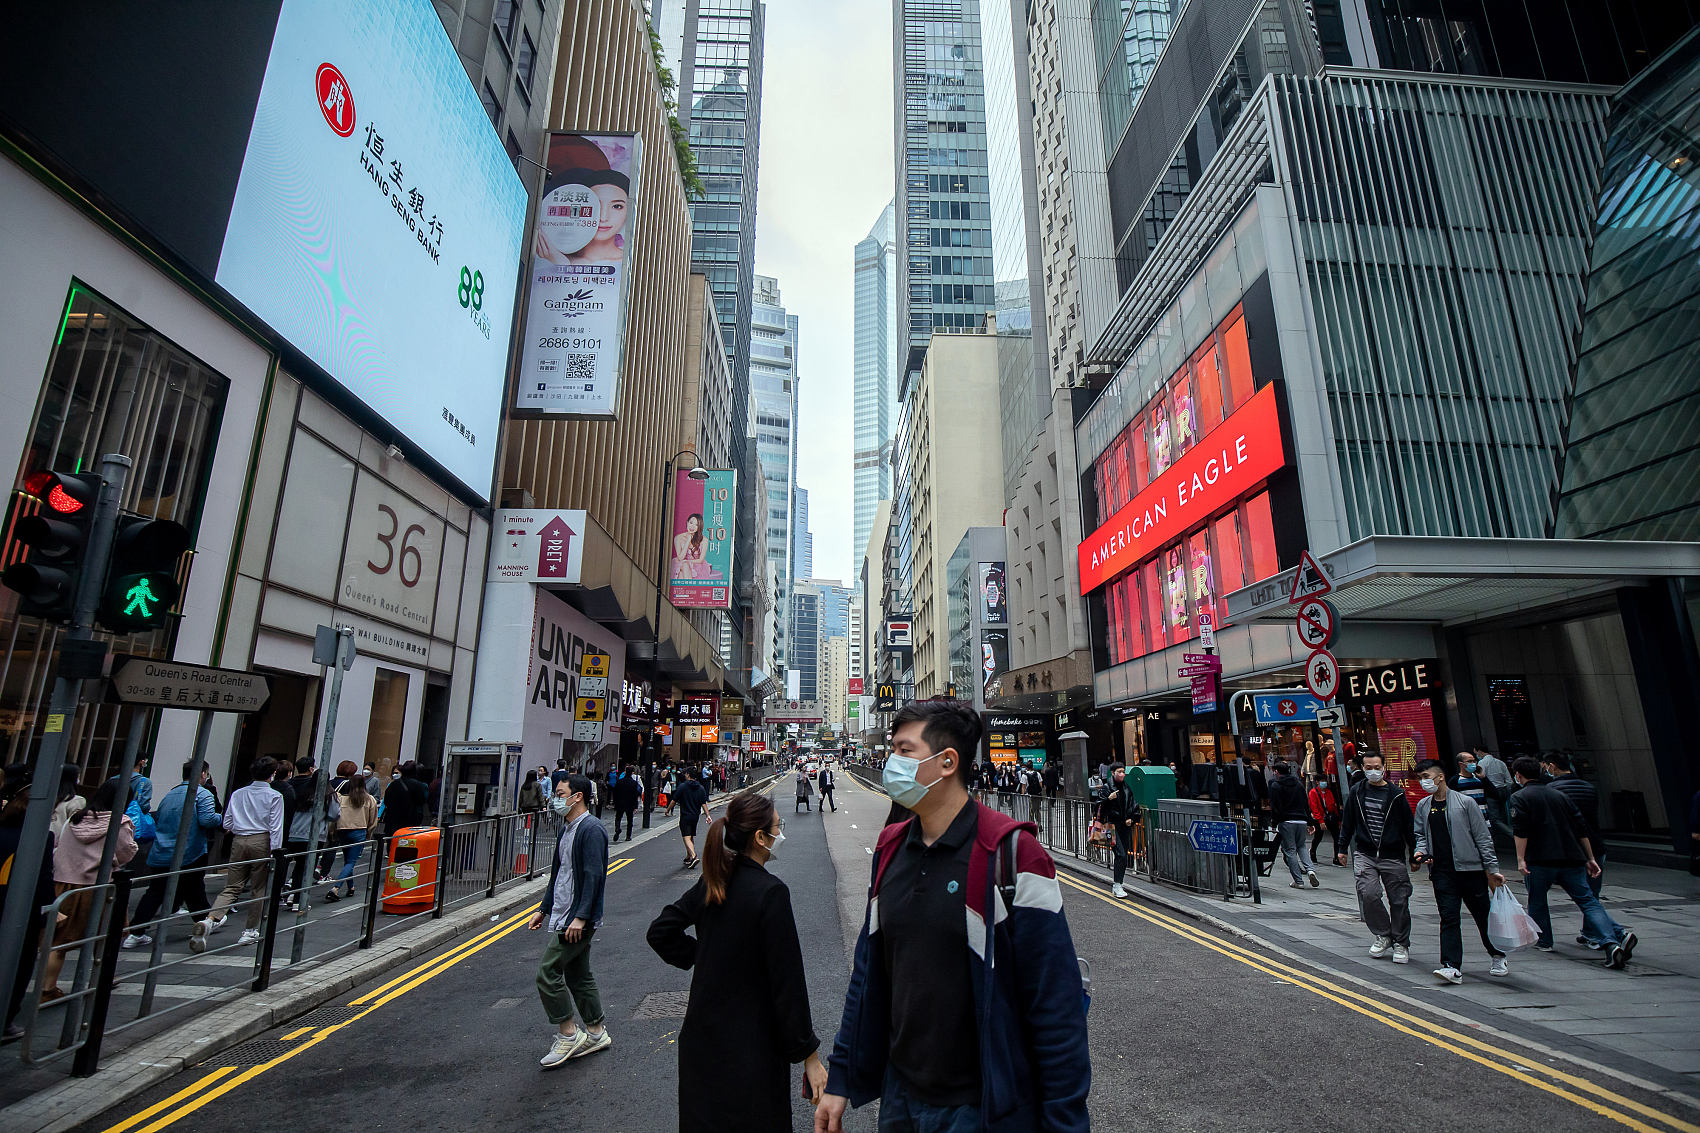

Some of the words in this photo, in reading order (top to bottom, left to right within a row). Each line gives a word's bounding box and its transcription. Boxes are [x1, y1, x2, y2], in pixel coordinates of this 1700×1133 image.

[360, 150, 389, 197] HANG
[390, 194, 416, 231] SENG
[417, 228, 440, 265] BANK
[458, 265, 485, 311] 88
[544, 300, 604, 311] Gangnam
[470, 305, 491, 340] YEARS
[539, 337, 570, 349] 2686
[572, 338, 602, 350] 9101
[1091, 497, 1168, 570] AMERICAN
[1177, 434, 1248, 507] EAGLE
[367, 504, 426, 588] 36
[547, 540, 563, 563] PRET
[345, 584, 377, 606] Queen's
[380, 599, 399, 613] Road
[402, 607, 428, 625] Central
[358, 628, 371, 639] WAI
[373, 634, 404, 649] BUILDING
[145, 664, 187, 680] Queen's
[190, 670, 217, 684] Road
[220, 675, 252, 688] Central
[597, 678, 603, 686] 7
[1350, 664, 1429, 697] EAGLE
[126, 685, 155, 696] 30-36
[159, 686, 234, 706] 皇后大道中
[679, 704, 711, 714] 周大福
[1147, 712, 1160, 720] AE
[591, 733, 597, 741] 7
